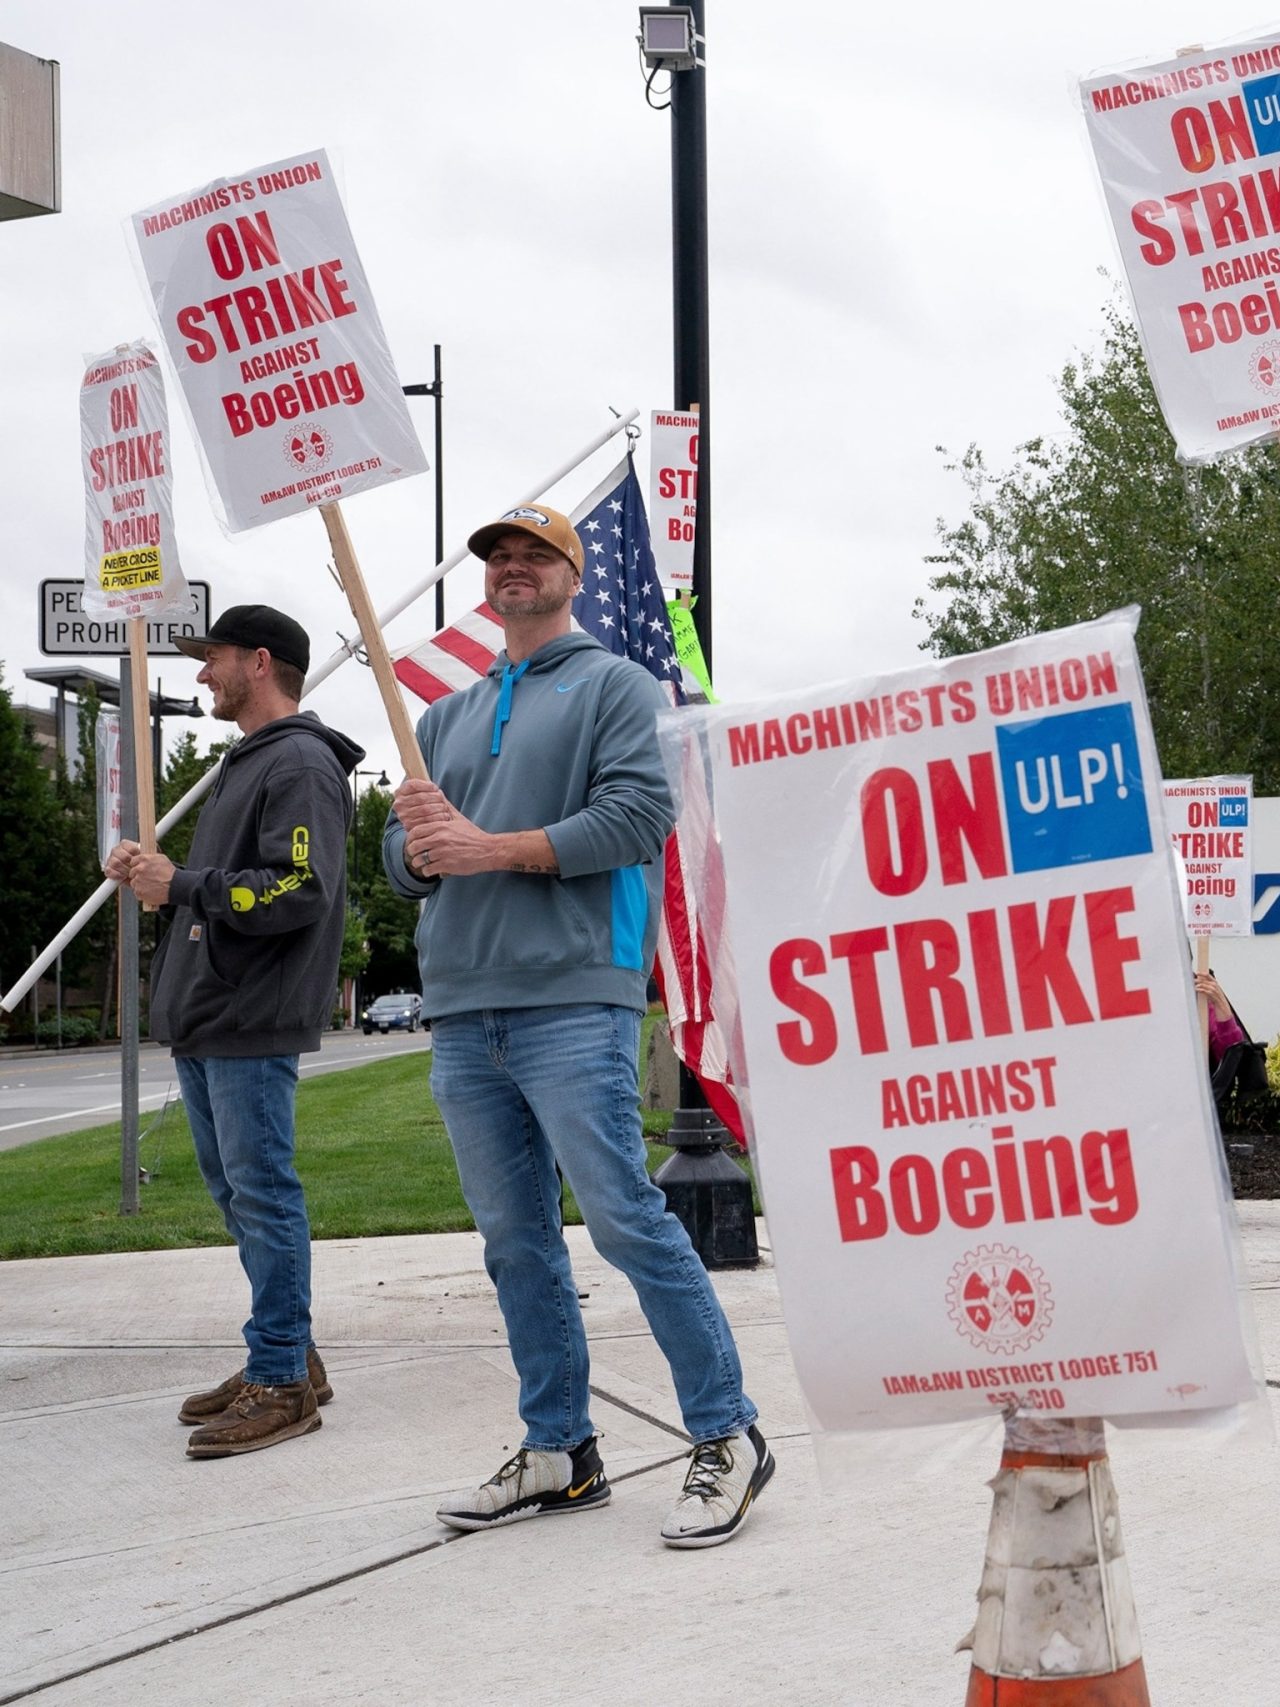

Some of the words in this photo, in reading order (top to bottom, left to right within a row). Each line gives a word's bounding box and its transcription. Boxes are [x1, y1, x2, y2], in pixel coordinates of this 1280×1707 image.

[1091, 58, 1231, 114] MACHINISTS
[1170, 95, 1257, 174] ON
[143, 180, 256, 237] MACHINISTS
[257, 161, 322, 196] UNION
[206, 211, 281, 282] ON
[176, 259, 357, 364] STRIKE
[239, 337, 324, 384] AGAINST
[110, 383, 138, 434] ON
[221, 362, 365, 438] Boeing
[656, 415, 700, 428] MACHIN
[1216, 409, 1260, 431] IAM&AW
[89, 430, 165, 493] STRIKE
[689, 434, 699, 465] O
[260, 483, 297, 505] IAM&AW
[296, 471, 337, 495] DISTRICT
[336, 461, 366, 479] LODGE
[365, 457, 382, 470] 751
[102, 512, 161, 553] Boeing
[102, 574, 110, 587] A
[111, 572, 139, 587] PICKET
[129, 551, 158, 565] CROSS
[57, 622, 195, 643] PROHIITED
[727, 679, 976, 767] MACHINISTS
[985, 650, 1119, 717] UNION
[1014, 742, 1128, 814] ULP!
[1164, 787, 1217, 797] ACHINISTS
[1218, 786, 1247, 795] UNION
[860, 751, 1008, 897] ON
[1188, 801, 1218, 828] ON
[1221, 803, 1246, 816] ULP!
[1172, 832, 1244, 859] TRIKE
[1187, 875, 1236, 898] oeing
[769, 885, 1152, 1067] STRIKE
[881, 1056, 1057, 1130] AGAINST
[829, 1125, 1140, 1243] Boeing
[882, 1369, 964, 1396] IAM&AW
[967, 1362, 1054, 1389] DISTRICT
[1058, 1355, 1122, 1382] LODGE
[1122, 1350, 1159, 1374] 751
